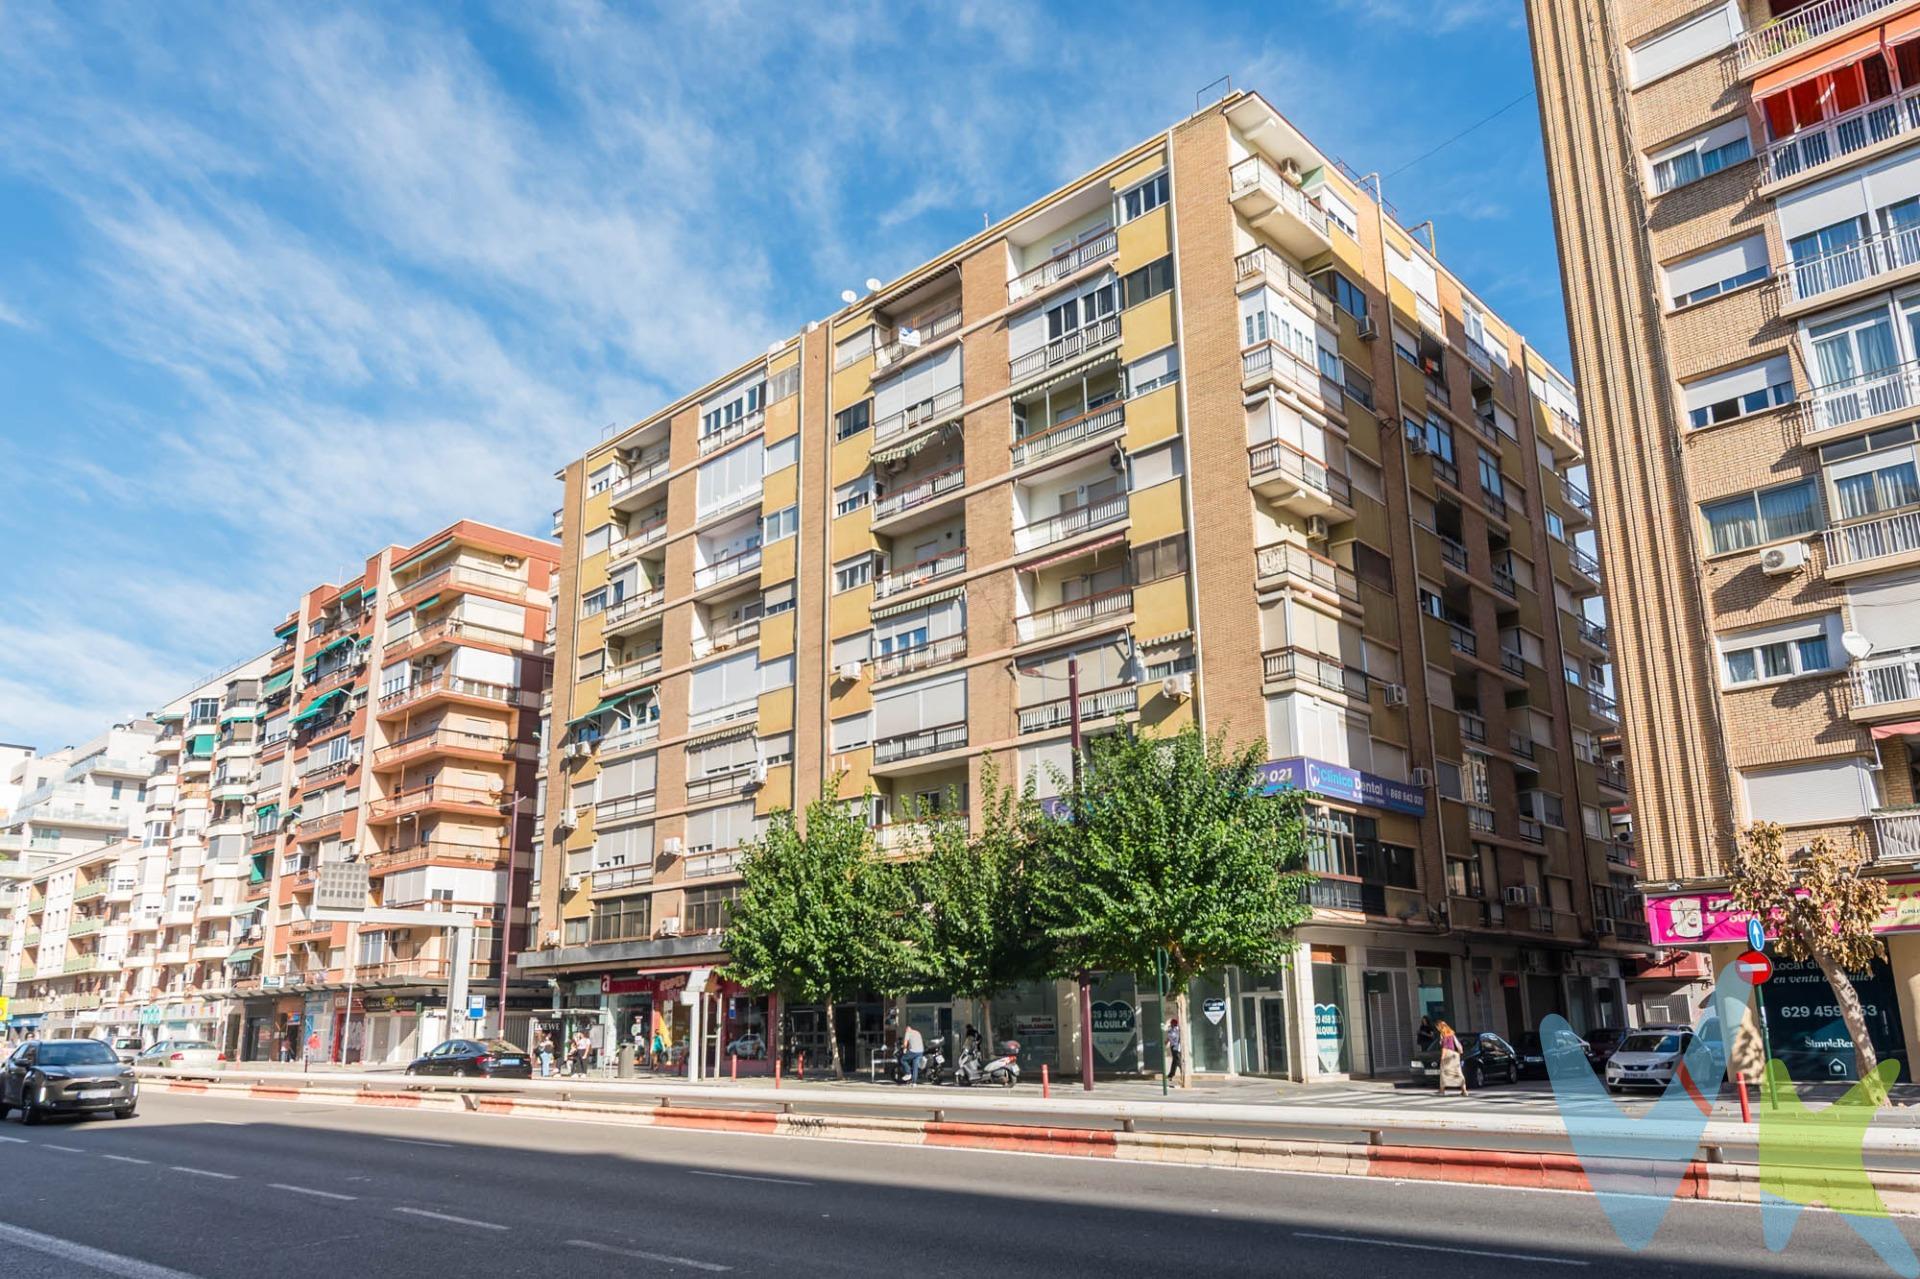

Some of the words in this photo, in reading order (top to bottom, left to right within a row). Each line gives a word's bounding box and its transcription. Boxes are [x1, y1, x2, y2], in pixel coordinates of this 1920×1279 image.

[1269, 767, 1293, 783] 021
[1354, 777, 1383, 796] Dental
[1772, 958, 1804, 971] Local
[1773, 976, 1785, 984] en
[1789, 974, 1820, 984] venta
[1781, 1006, 1811, 1018] 629
[1814, 1005, 1841, 1017] 459
[1094, 1020, 1127, 1029] ALQUILA
